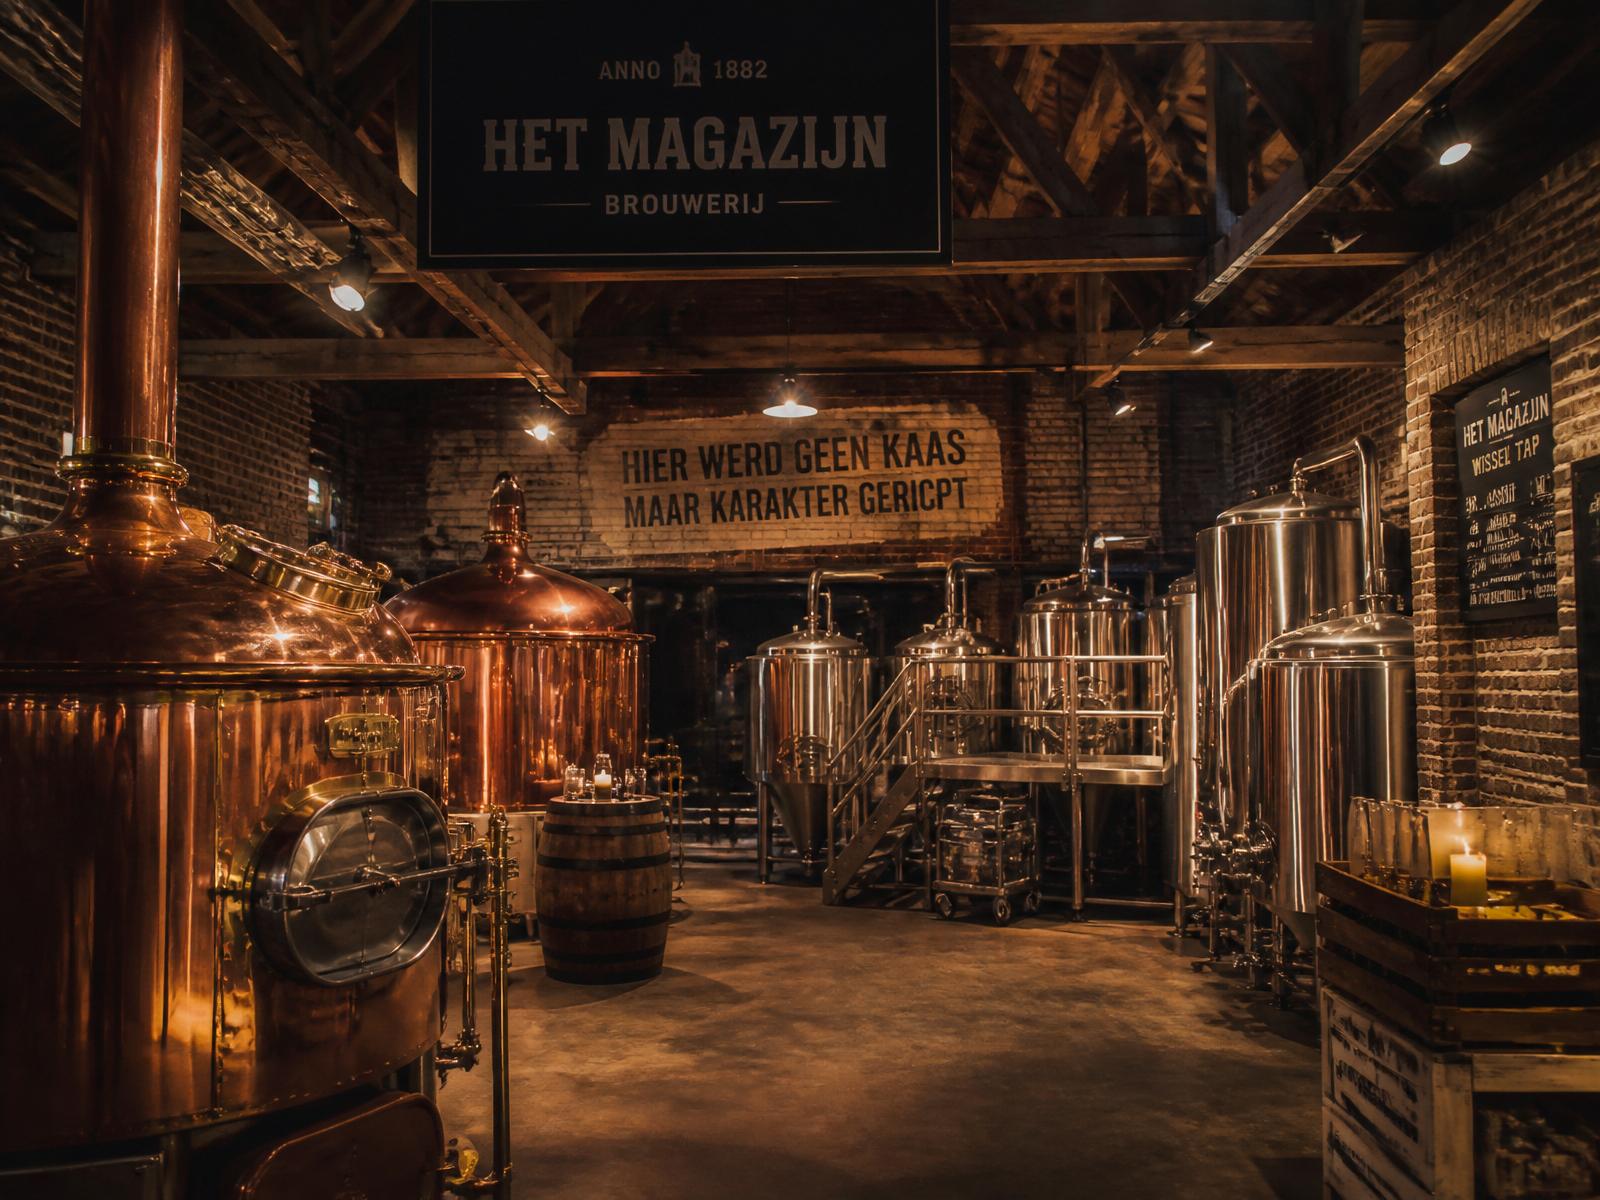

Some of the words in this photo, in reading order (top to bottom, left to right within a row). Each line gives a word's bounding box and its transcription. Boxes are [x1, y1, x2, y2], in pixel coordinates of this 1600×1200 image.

[599, 60, 661, 80] ANNO
[714, 60, 768, 79] 1882
[482, 117, 588, 172] HET
[607, 115, 887, 171] MAGAZIJN
[605, 193, 764, 215] BROUWERIJ
[1463, 420, 1484, 448] HET
[1471, 445, 1511, 477] WISSEL
[1515, 433, 1540, 461] TAP
[622, 448, 688, 484] HIER
[698, 441, 782, 480] WERD
[794, 435, 870, 474] GEEN
[882, 429, 966, 469] KAAS
[624, 490, 700, 528] MAAR
[711, 484, 849, 524] KARAKTER
[859, 477, 968, 515] GERICPT
